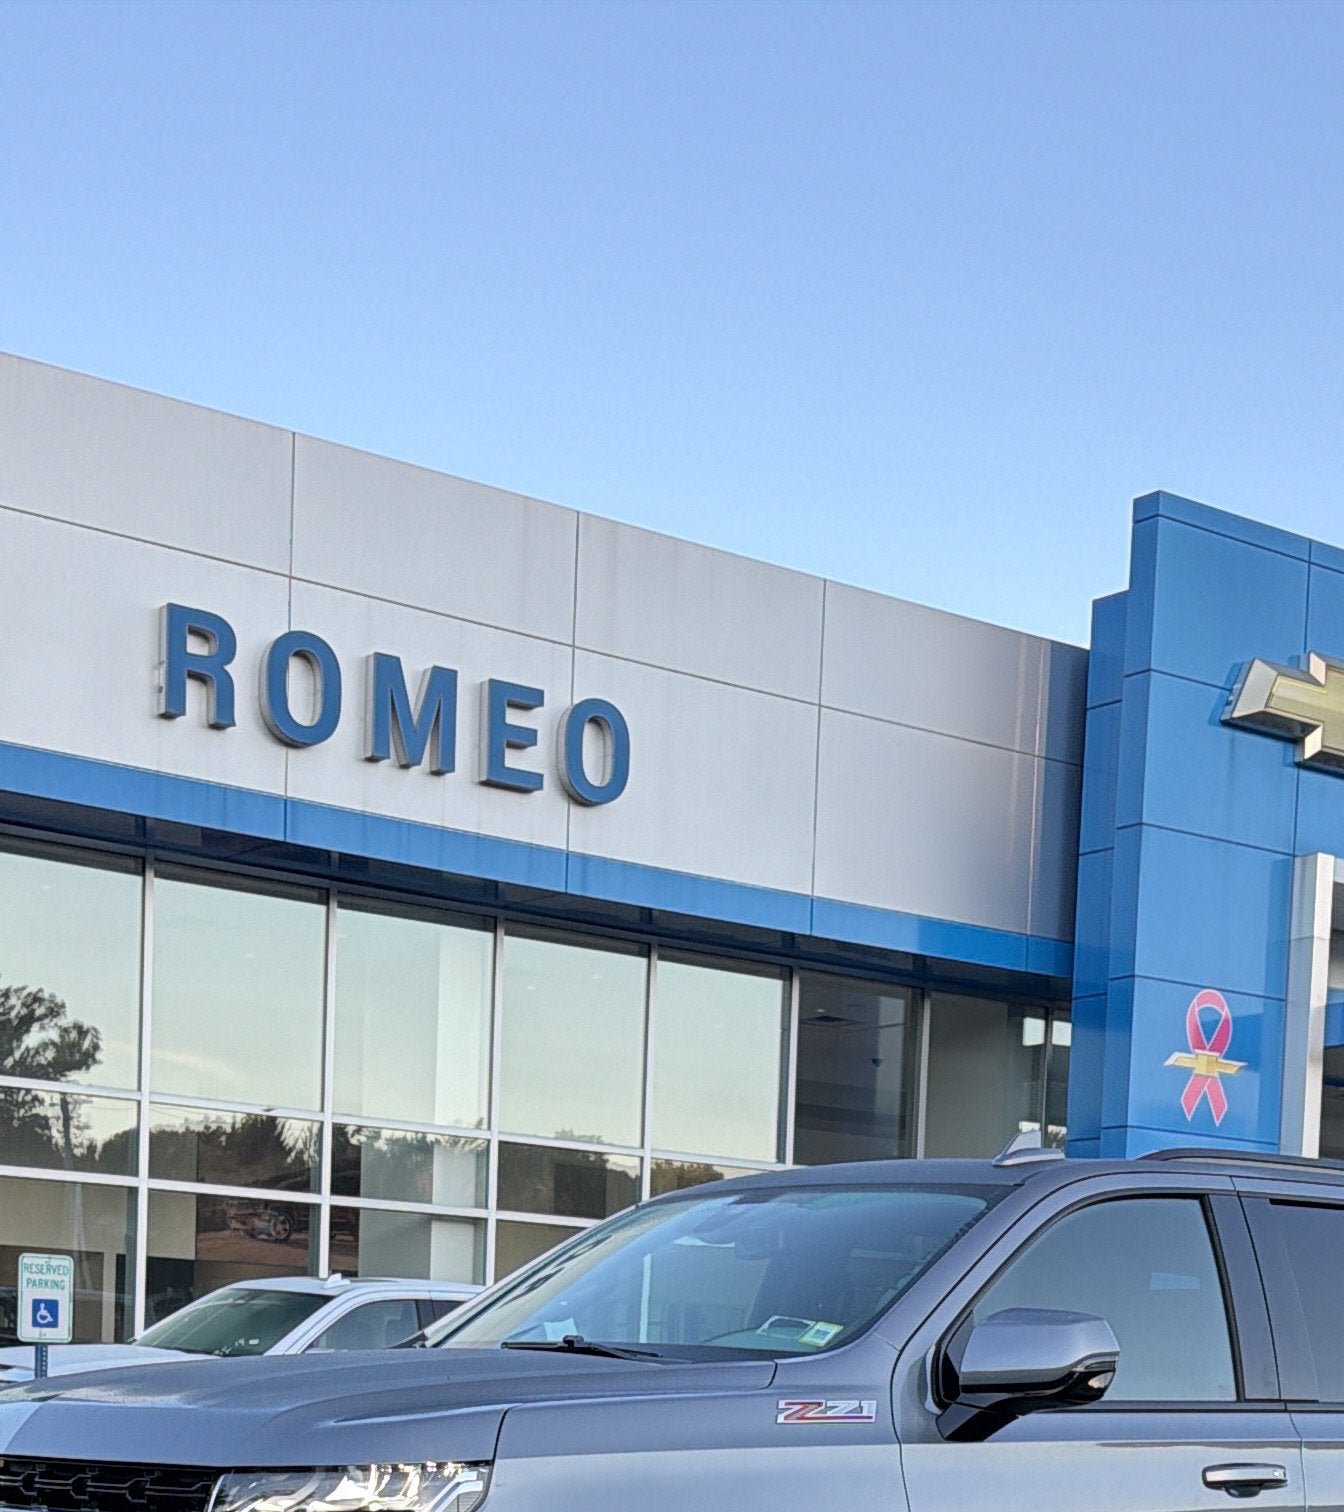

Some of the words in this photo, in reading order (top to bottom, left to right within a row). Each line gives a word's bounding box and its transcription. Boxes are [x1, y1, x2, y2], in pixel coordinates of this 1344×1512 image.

[158, 602, 630, 807] ROMEO
[23, 1263, 69, 1276] RESERVED
[26, 1278, 66, 1291] PARKING
[777, 1400, 877, 1423] Z71
